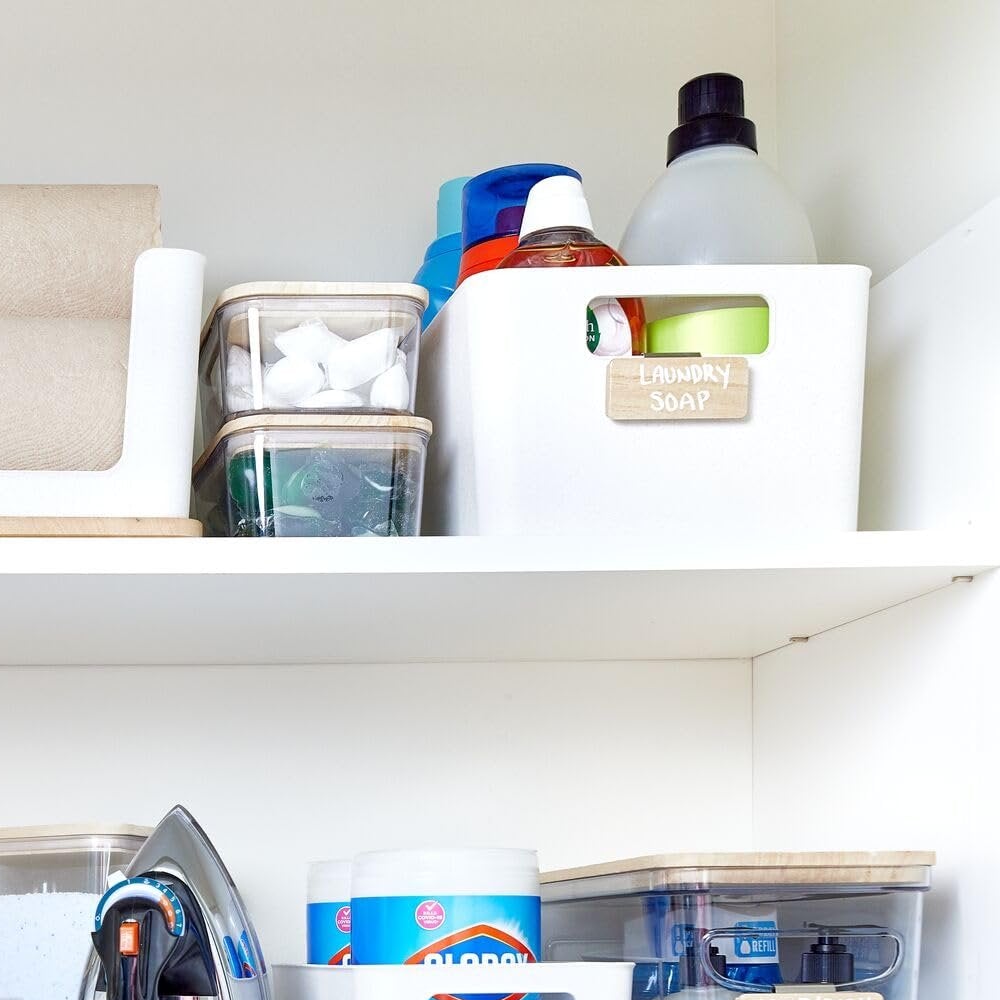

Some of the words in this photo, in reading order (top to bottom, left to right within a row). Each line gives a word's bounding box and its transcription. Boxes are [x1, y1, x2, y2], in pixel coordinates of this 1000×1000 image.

[639, 363, 731, 390] LAUNDRY
[648, 390, 712, 413] SOAP
[752, 941, 776, 953] REFILL
